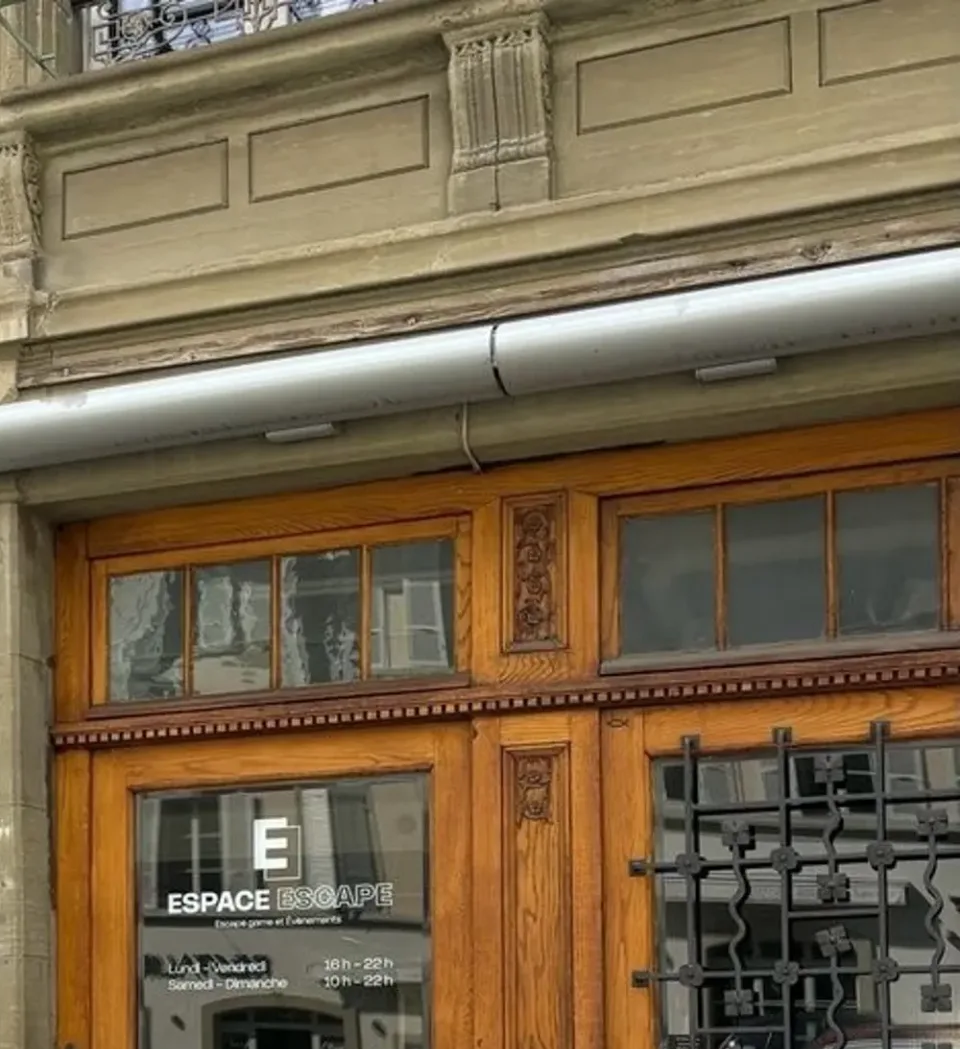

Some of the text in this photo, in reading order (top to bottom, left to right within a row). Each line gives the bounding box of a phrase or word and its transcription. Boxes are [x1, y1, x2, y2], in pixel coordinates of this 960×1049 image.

[253, 817, 288, 870] E
[167, 882, 394, 914] ESPACE ESCAPE
[214, 918, 247, 929] Escape
[248, 918, 274, 929] game
[275, 917, 285, 927] et
[167, 962, 200, 975] Lundi
[211, 960, 267, 974] Vendredi
[167, 979, 214, 991] Samedi
[225, 978, 289, 990] Dimanche
